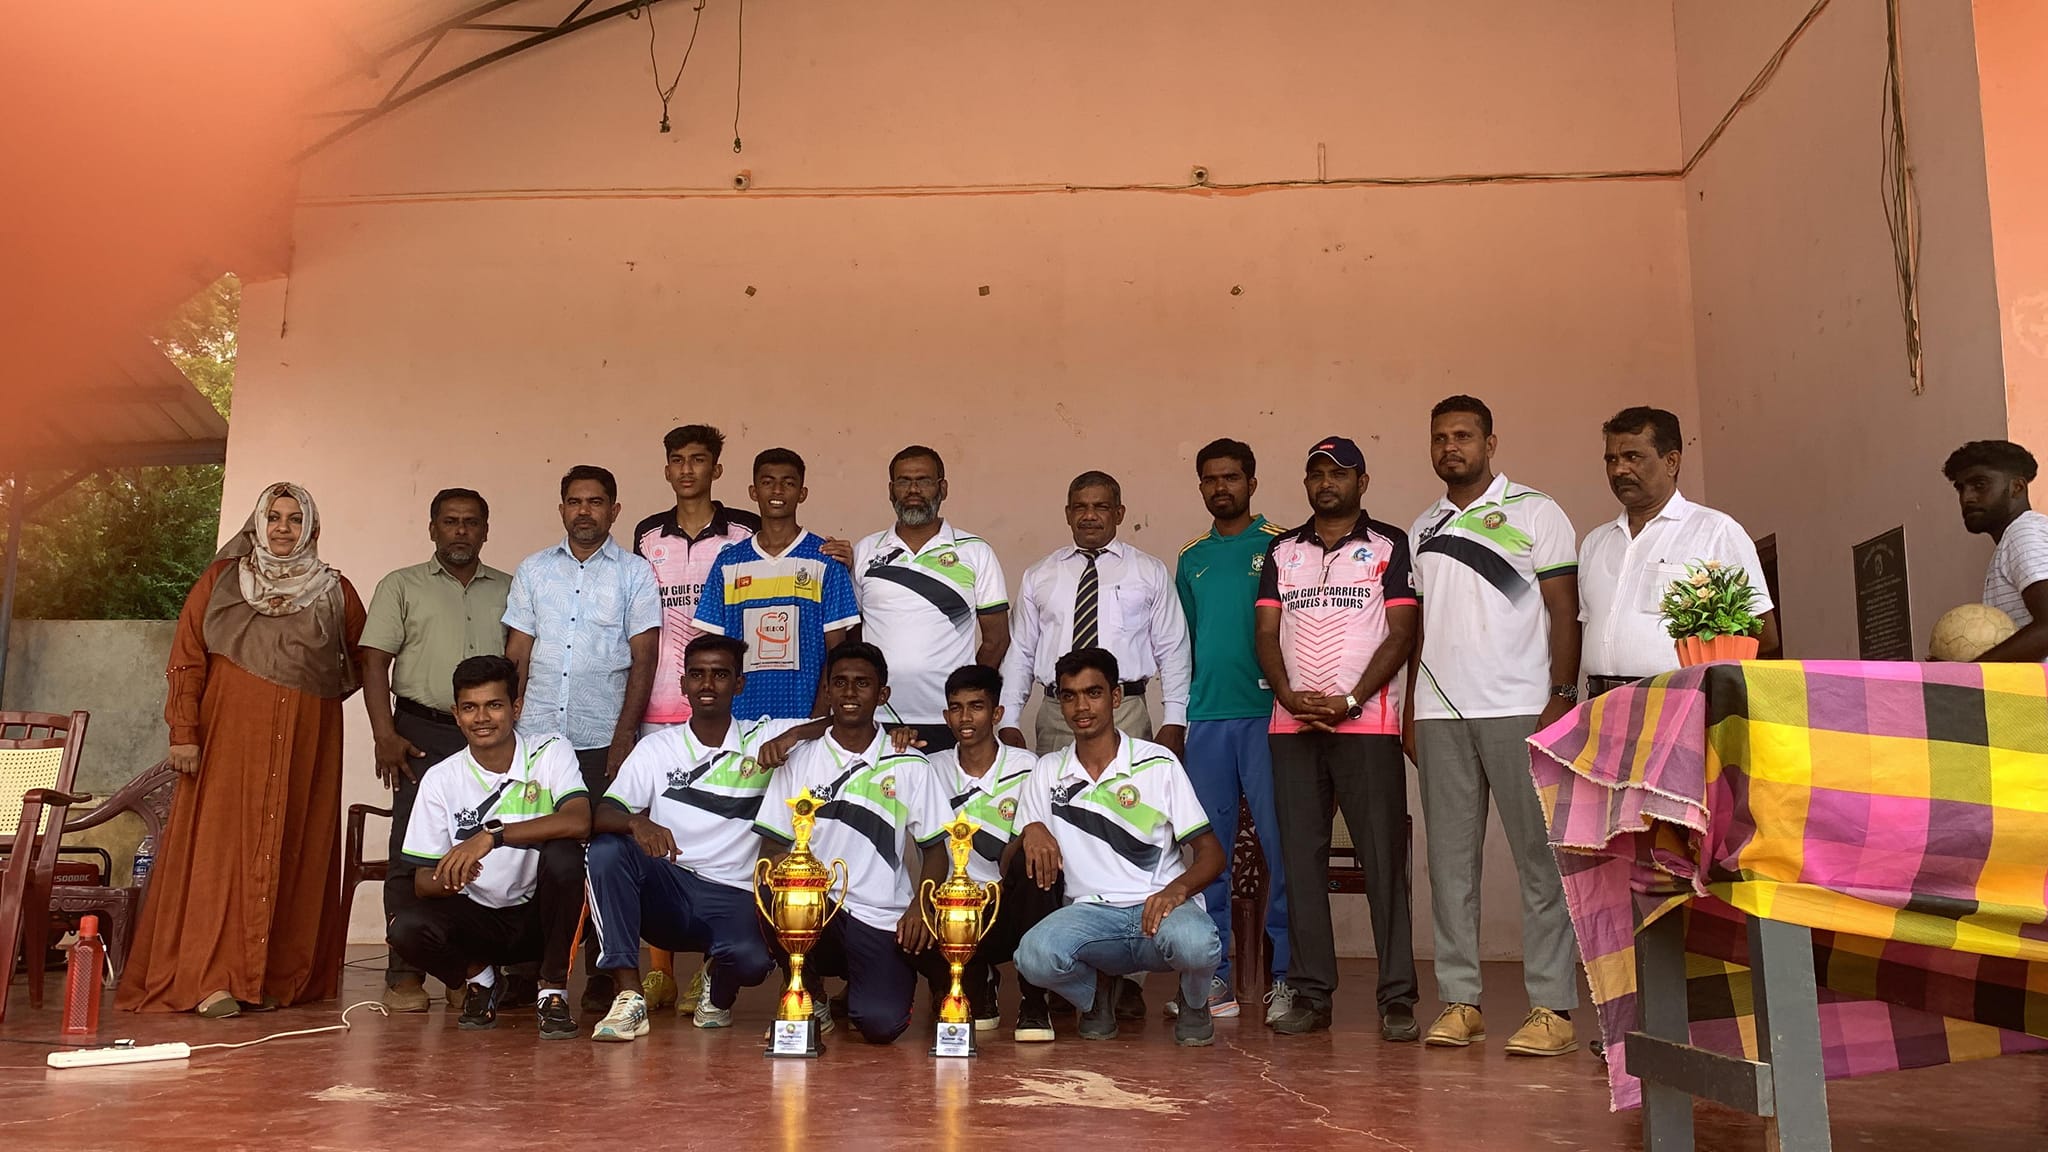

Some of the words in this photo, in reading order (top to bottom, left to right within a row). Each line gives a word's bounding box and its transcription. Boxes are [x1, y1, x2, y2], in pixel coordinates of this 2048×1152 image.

[671, 584, 692, 597] GULF
[1281, 589, 1300, 603] NEW
[1300, 586, 1322, 598] GULF
[1323, 586, 1371, 598] CARRIERS
[661, 595, 691, 608] RAVELS
[1287, 597, 1321, 612] TRAVELS
[1331, 597, 1364, 609] TOURS
